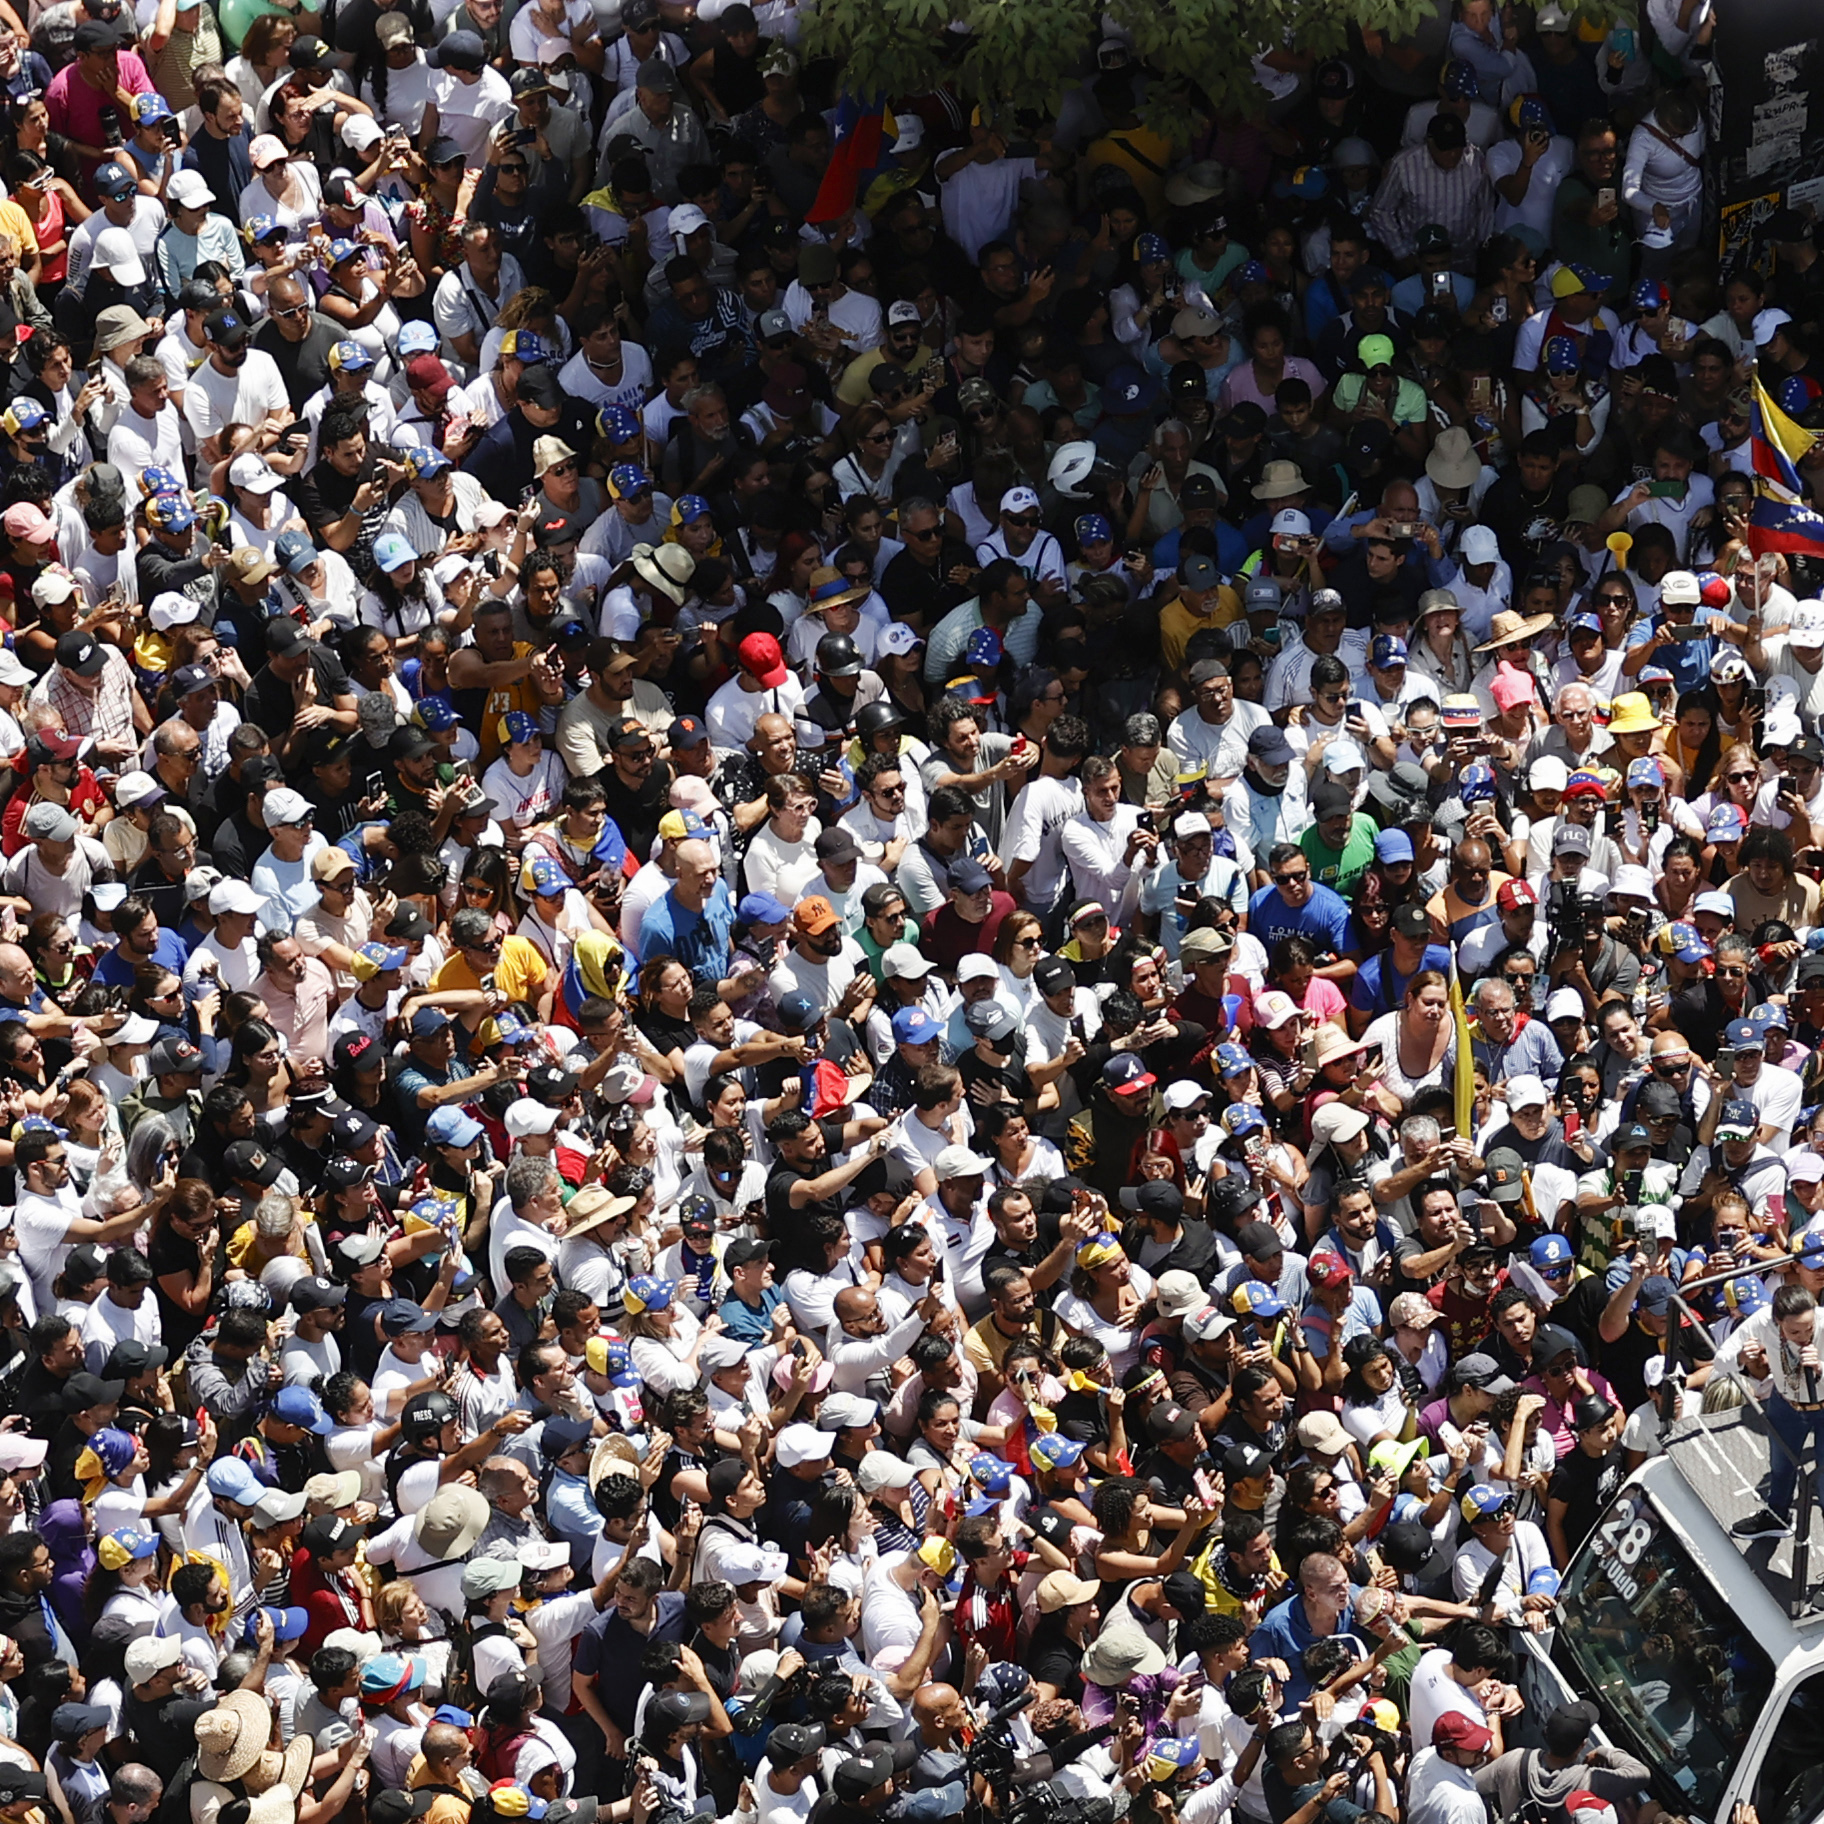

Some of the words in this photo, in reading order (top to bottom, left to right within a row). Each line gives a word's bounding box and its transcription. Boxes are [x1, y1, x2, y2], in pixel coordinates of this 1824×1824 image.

[1562, 831, 1584, 842] FLC
[1268, 925, 1316, 937] TOMMY
[347, 1037, 372, 1056] Barbie
[413, 1408, 432, 1422] PRESS
[1600, 1499, 1651, 1564] 28
